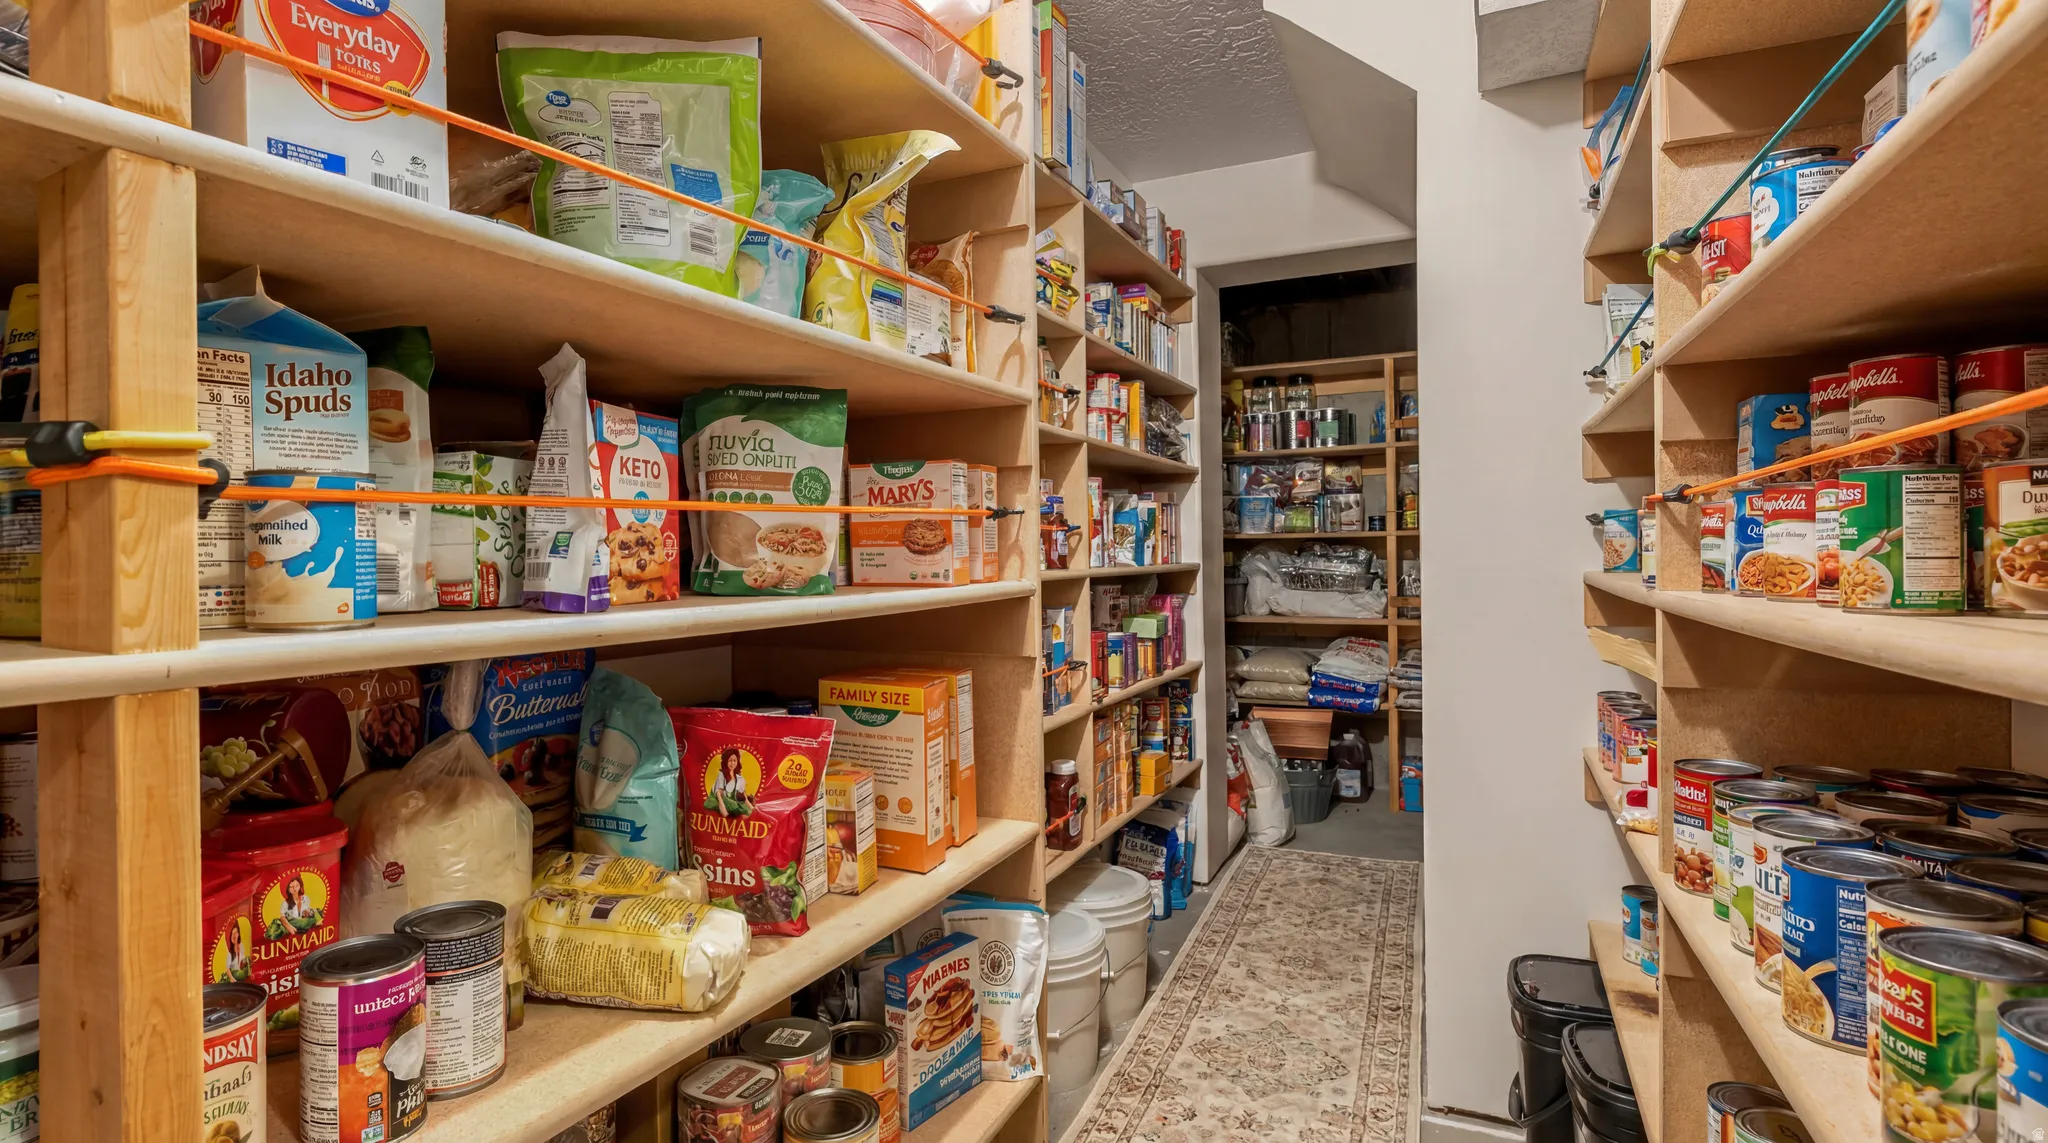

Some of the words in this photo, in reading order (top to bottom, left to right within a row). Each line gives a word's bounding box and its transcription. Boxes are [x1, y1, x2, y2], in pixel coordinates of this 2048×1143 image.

[290, 1, 400, 63] Everyday
[212, 349, 246, 364] Facts
[264, 361, 352, 388] Idaho
[232, 394, 250, 406] 150
[264, 387, 352, 421] Spuds
[619, 455, 661, 480] KETO
[258, 533, 282, 545] Milk
[829, 686, 878, 703] FAMILY
[880, 691, 911, 706] SIZE
